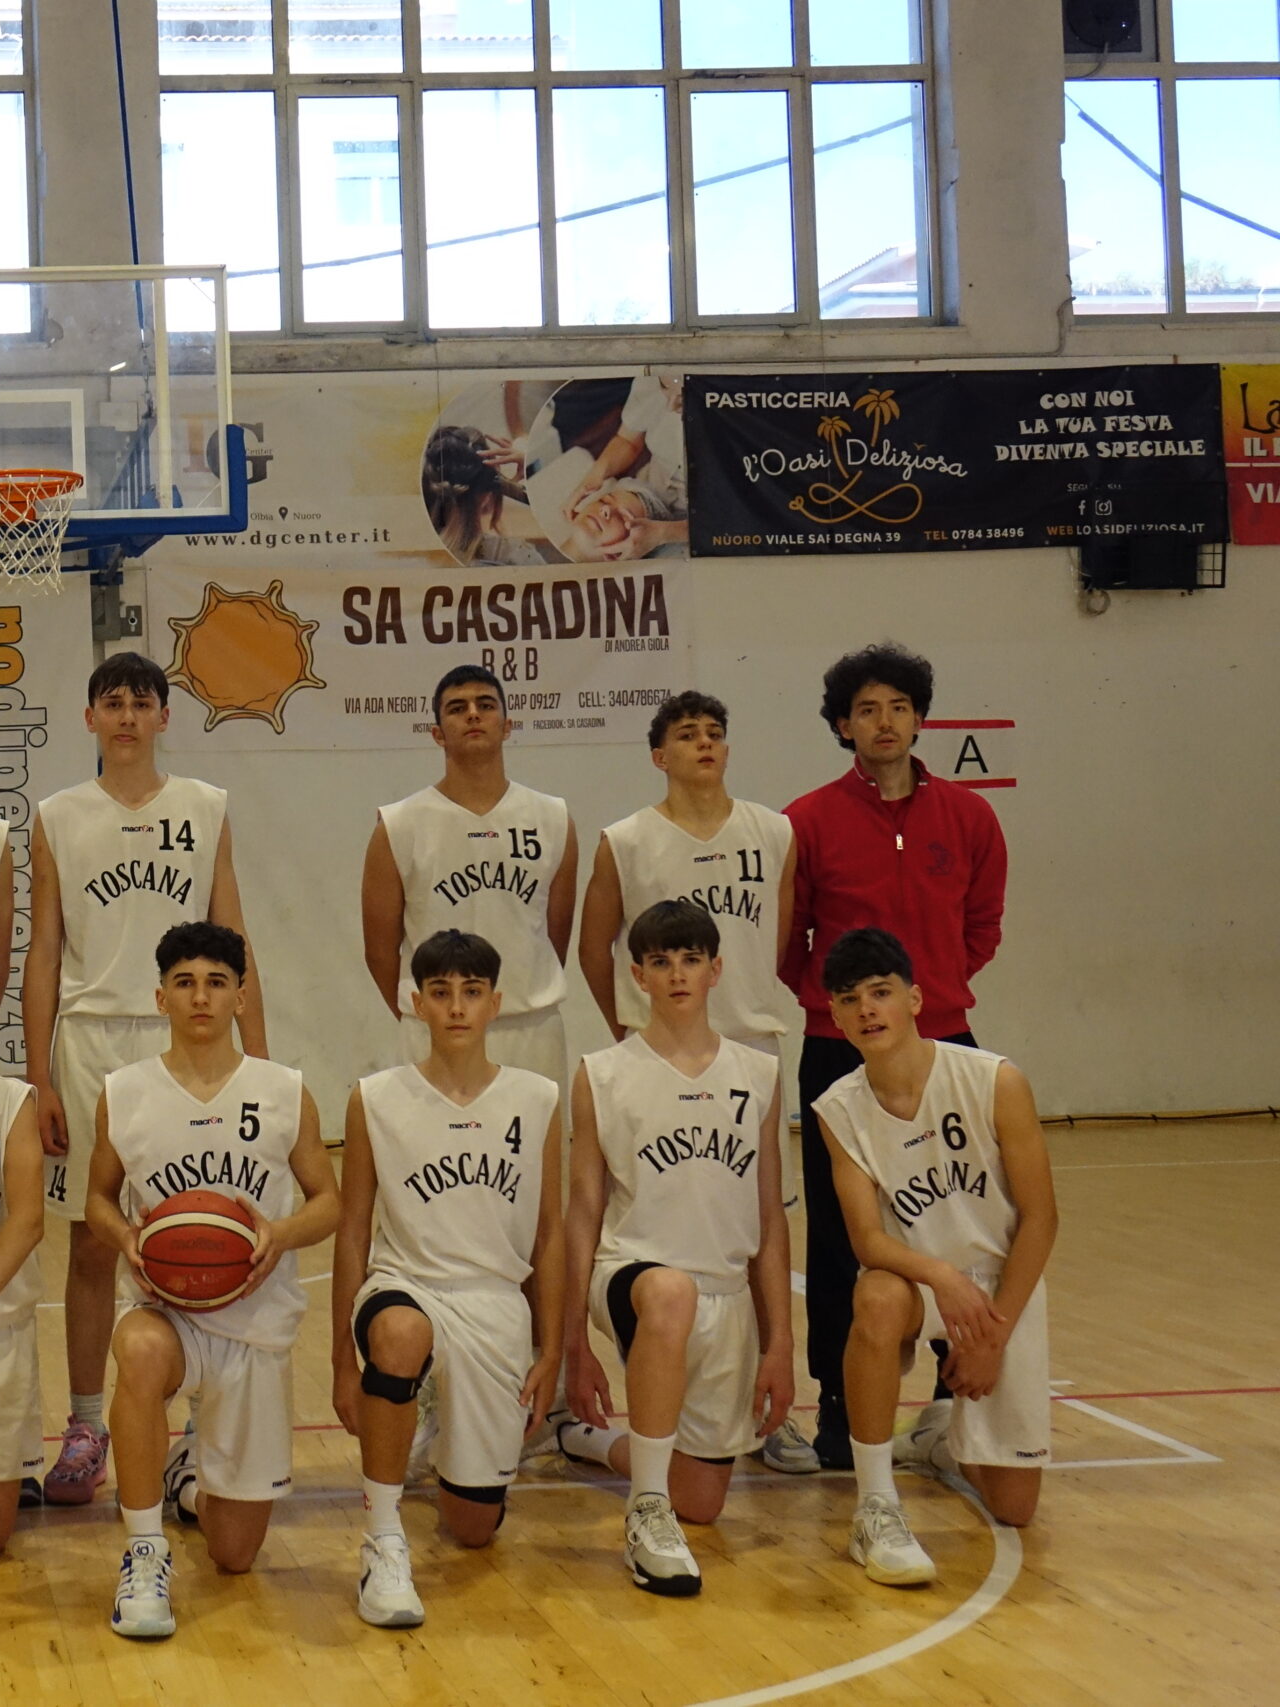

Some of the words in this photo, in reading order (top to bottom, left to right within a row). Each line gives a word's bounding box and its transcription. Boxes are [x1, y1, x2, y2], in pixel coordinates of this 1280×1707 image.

[705, 392, 850, 408] PASTICCERIA
[1040, 392, 1086, 410] CON
[1094, 389, 1135, 407] NOI
[1019, 419, 1049, 435] LA
[1056, 416, 1096, 433] TUA
[1104, 415, 1173, 432] FESTA
[743, 448, 832, 483] l'Oasi
[846, 438, 968, 480] Deliziosa
[994, 443, 1090, 462] DIVENTA
[1096, 439, 1206, 458] SPECIALE
[1243, 437, 1267, 457] IL
[250, 512, 274, 521] Olbia
[293, 511, 322, 520] Nuoro
[1046, 526, 1074, 536] WEB
[185, 528, 392, 548] www.dgcenter.it
[766, 534, 805, 545] VIALE
[885, 532, 901, 543] 39
[924, 530, 948, 540] TEL
[952, 528, 982, 540] 0784
[986, 527, 1024, 539] 38496
[342, 586, 407, 645] SA
[422, 574, 670, 645] CASADINA
[605, 640, 612, 653] DI
[615, 639, 646, 652] ANDREA
[502, 647, 518, 682] &
[525, 647, 538, 681] B
[344, 697, 361, 714] VIA
[364, 696, 384, 714] ADA
[387, 696, 417, 713] NEGRI
[420, 696, 428, 716] 7,
[507, 695, 527, 710] CAP
[529, 693, 560, 709] 09127
[579, 691, 606, 708] CELL:
[533, 719, 565, 730] FACEBOOK:
[567, 719, 576, 729] SA
[576, 718, 605, 729] CASADINA
[954, 735, 989, 774] A
[122, 825, 154, 833] macron
[159, 819, 195, 852] 14
[468, 831, 499, 839] macron
[508, 828, 542, 860] 15
[694, 853, 726, 863] macron
[737, 849, 764, 882] 11
[84, 860, 192, 907] TOSCANA
[433, 861, 538, 906] TOSCANA
[677, 885, 762, 928] SCANA
[190, 1115, 223, 1126] macron
[238, 1102, 260, 1141] 5
[679, 1091, 714, 1101] macron
[729, 1088, 750, 1125] 7
[449, 1121, 482, 1130] macron
[504, 1116, 522, 1155] 4
[942, 1112, 967, 1151] 6
[637, 1126, 757, 1178] TOSCANA
[48, 1165, 67, 1202] 14
[146, 1150, 270, 1202] TOSCANA
[404, 1152, 522, 1204] TOSCANA
